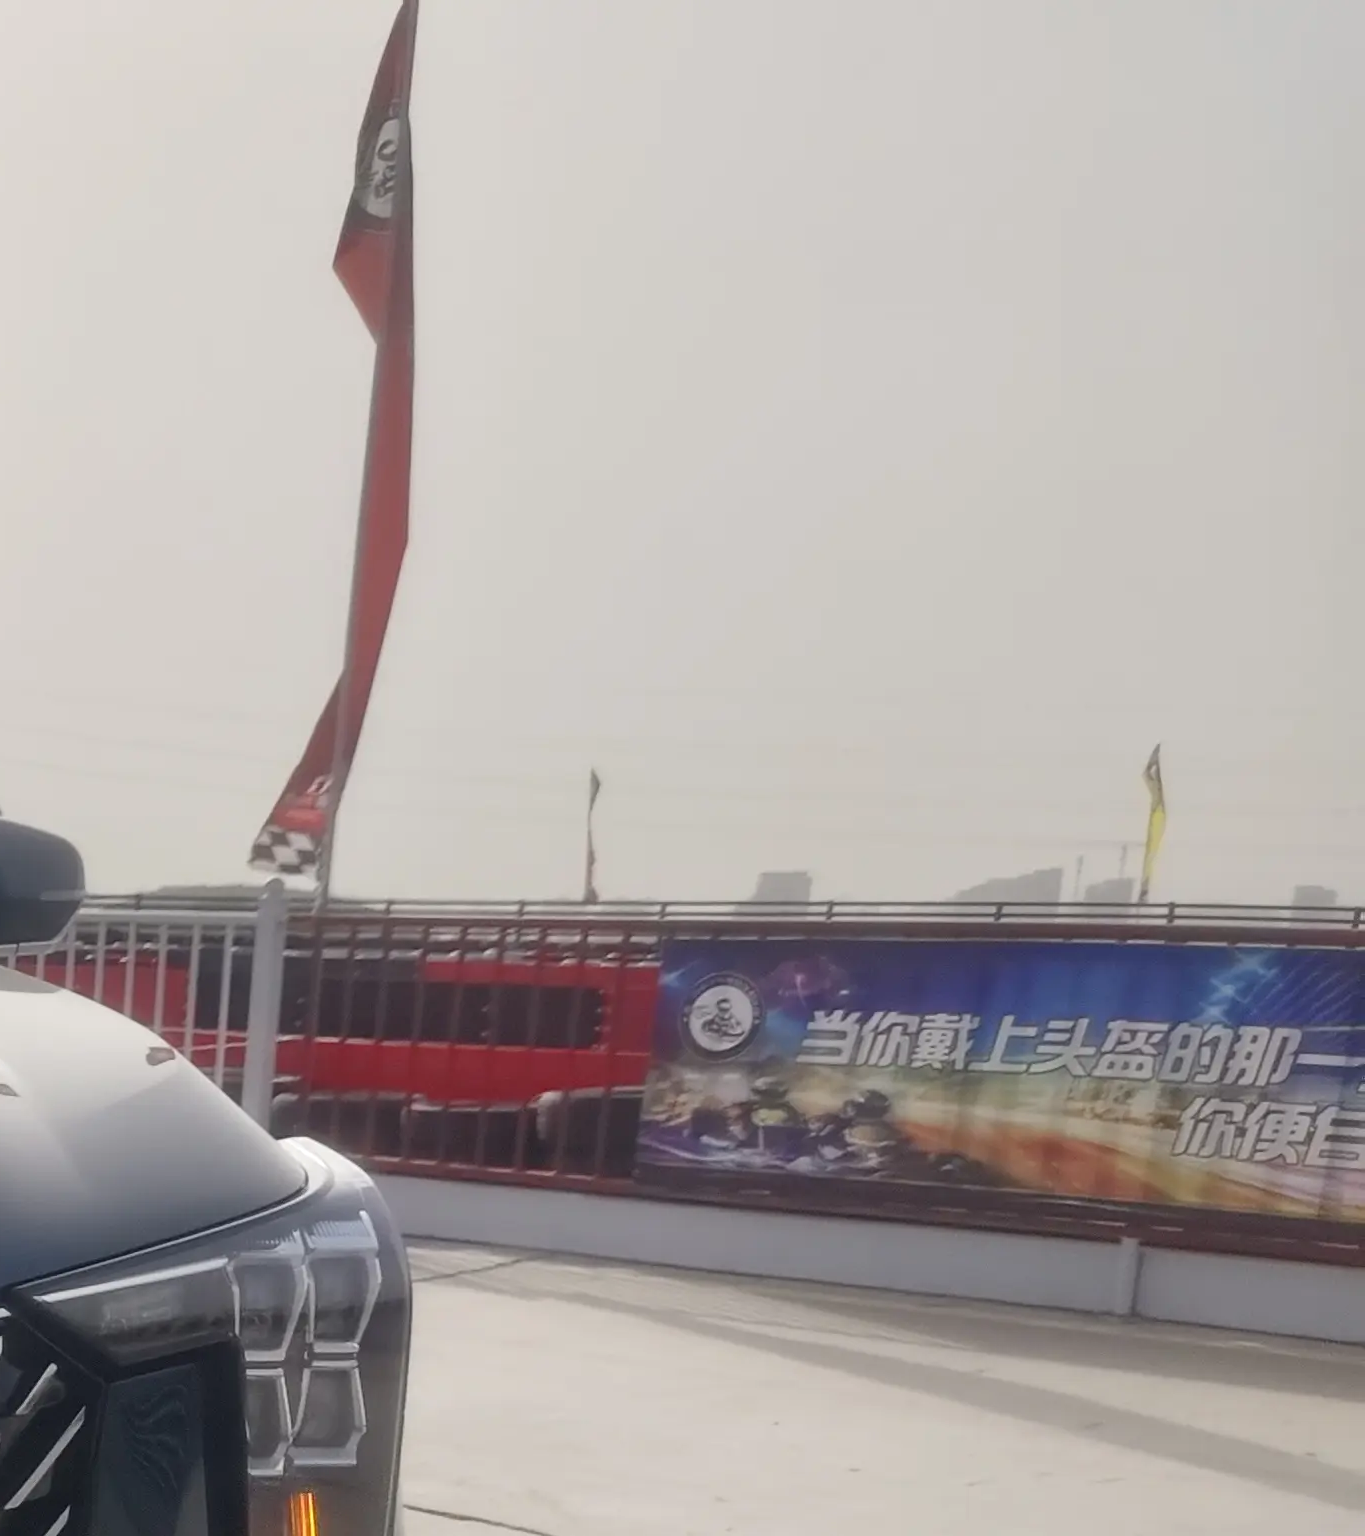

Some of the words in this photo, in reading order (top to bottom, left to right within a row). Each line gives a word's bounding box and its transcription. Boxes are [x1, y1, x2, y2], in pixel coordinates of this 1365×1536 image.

[796, 1009, 1365, 1092] 当你戴上头盔的那一
